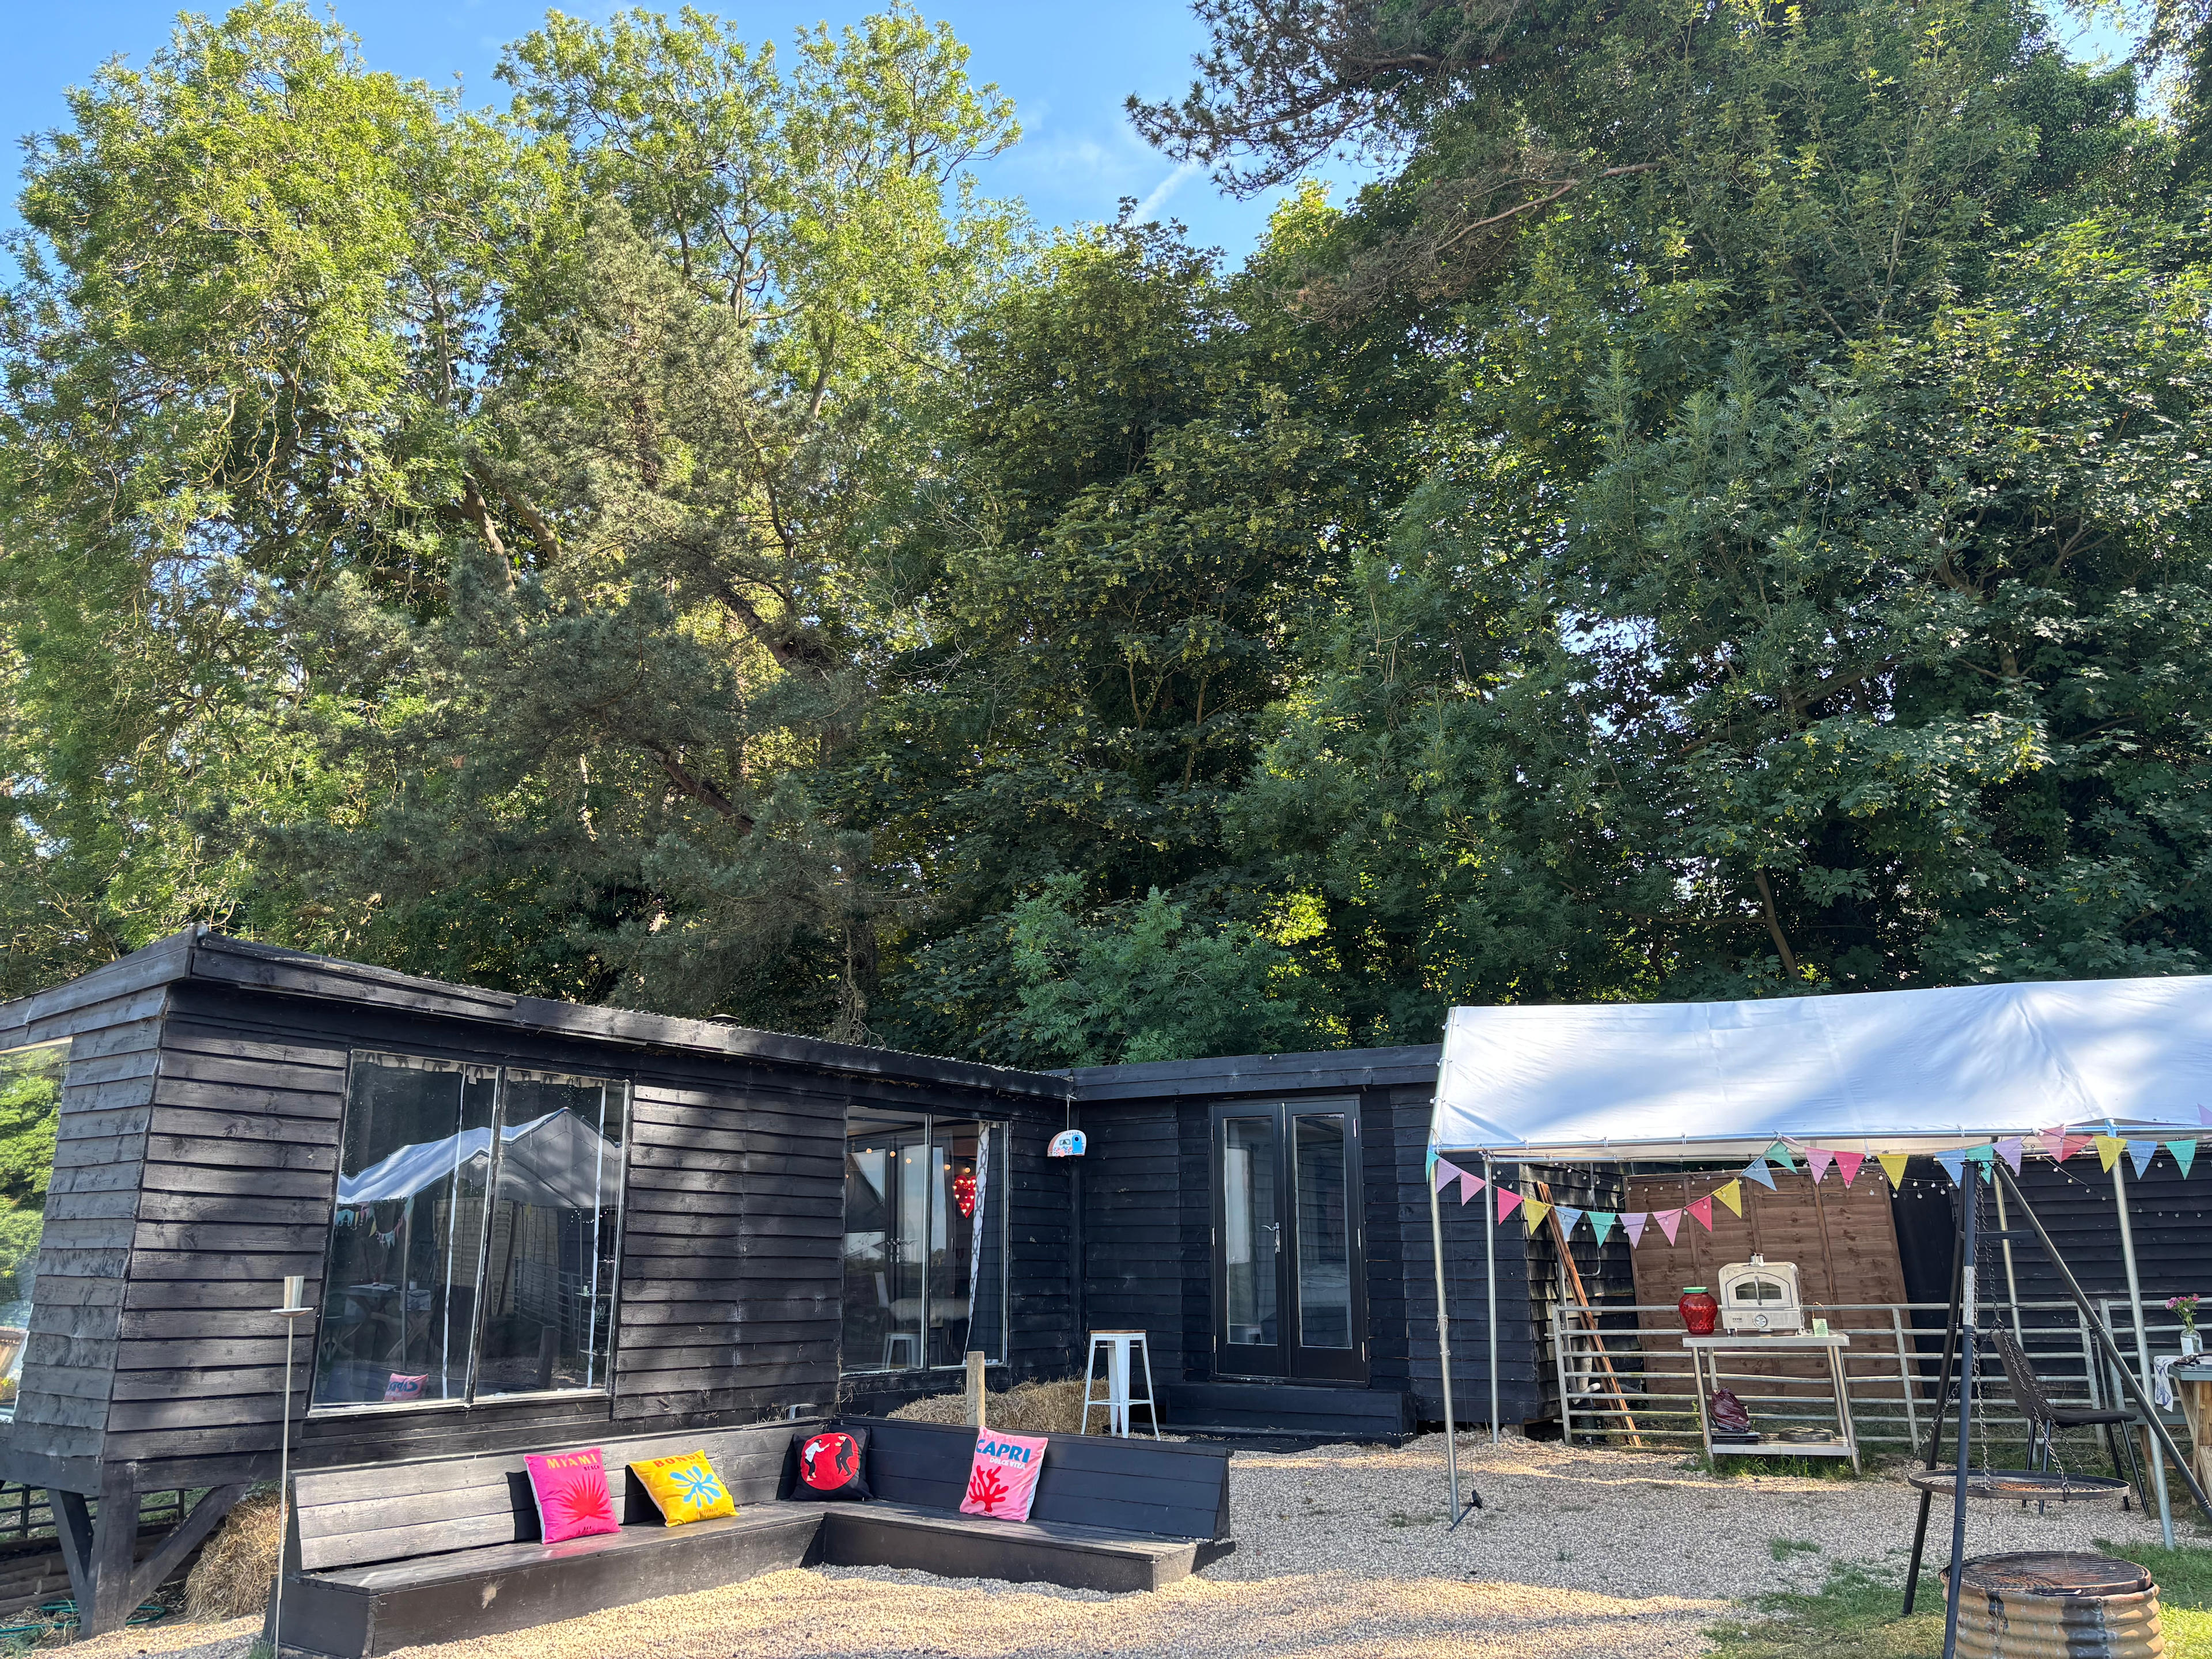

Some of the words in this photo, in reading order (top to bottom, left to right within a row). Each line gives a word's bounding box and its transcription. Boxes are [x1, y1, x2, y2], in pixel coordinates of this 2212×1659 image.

[976, 1439, 1031, 1463] CAPRI
[546, 1453, 597, 1469] MIAMI
[653, 1453, 702, 1468] BONDI
[989, 1457, 1009, 1466] DOLCE
[1009, 1461, 1025, 1470] VITA
